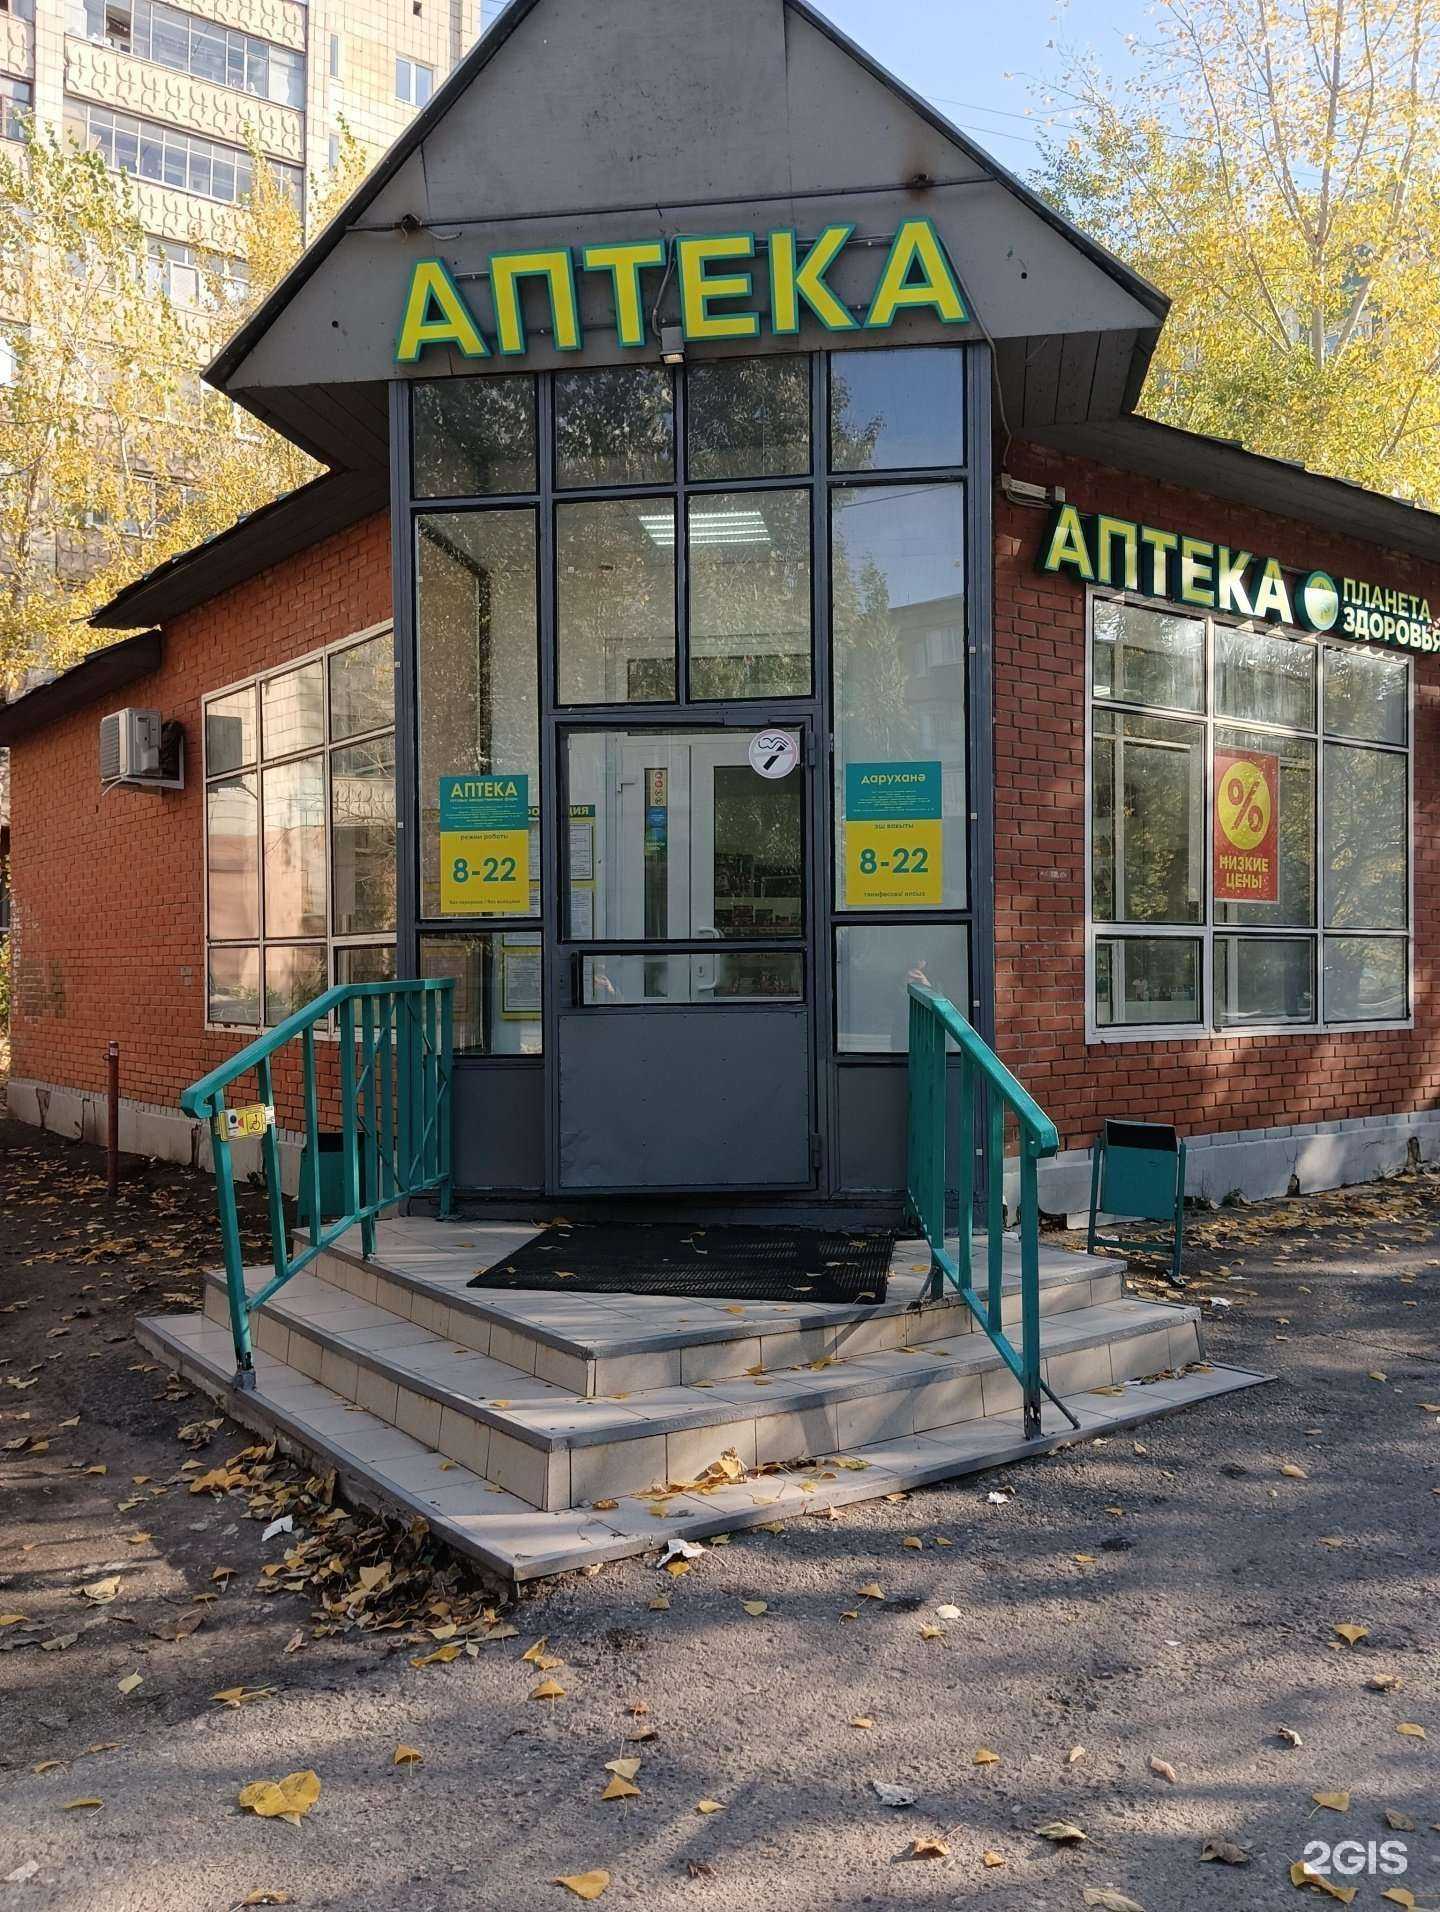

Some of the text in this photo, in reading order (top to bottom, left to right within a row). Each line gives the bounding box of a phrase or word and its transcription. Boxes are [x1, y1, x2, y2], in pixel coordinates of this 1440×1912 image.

[393, 216, 970, 364] АПТЕКА
[1044, 503, 1294, 624] АПТЕКА
[1343, 577, 1433, 623] ПЛАНЕТА
[1343, 606, 1440, 652] ЗДОРОВЬЯ
[450, 781, 518, 798] АПТЕКА
[452, 856, 518, 884] 8-22
[859, 847, 929, 875] 8-22
[1219, 854, 1270, 873] НИЗКИЕ
[1226, 872, 1263, 890] ЦЕНЫ
